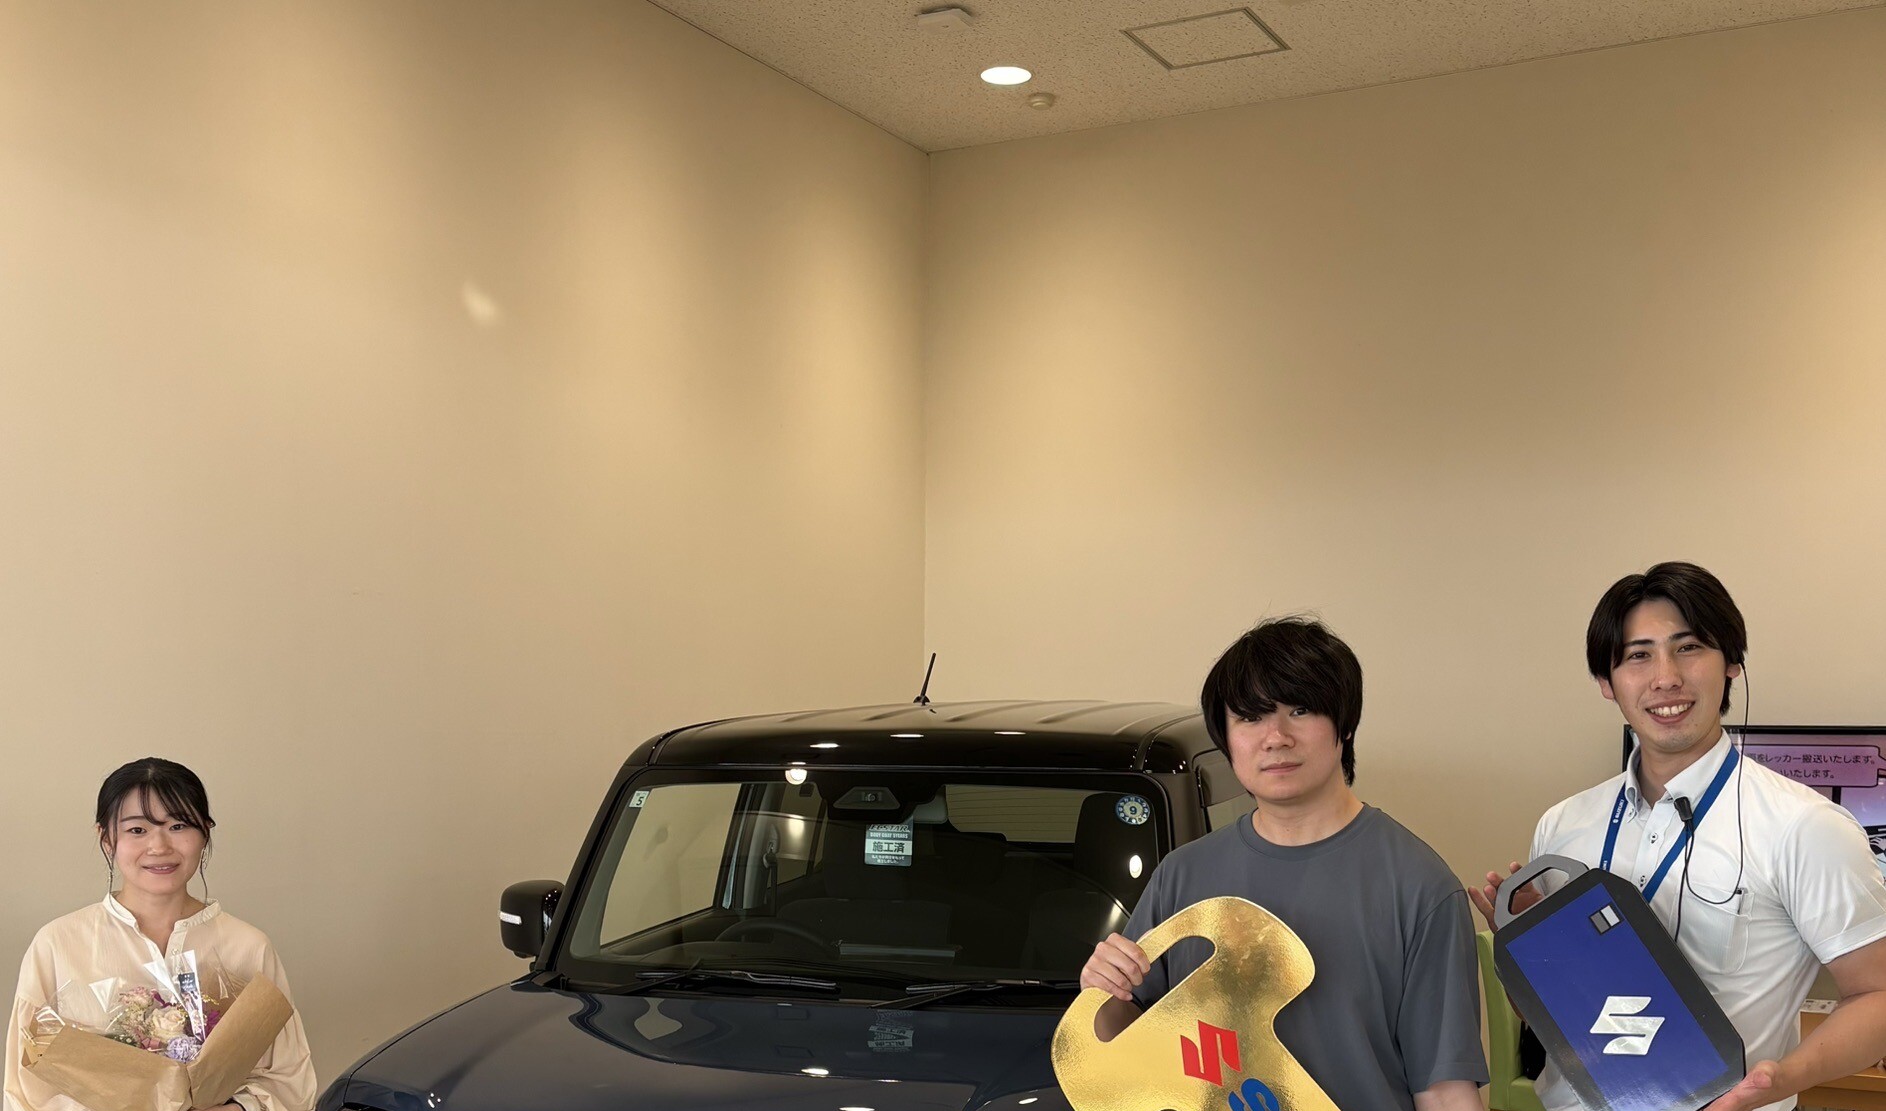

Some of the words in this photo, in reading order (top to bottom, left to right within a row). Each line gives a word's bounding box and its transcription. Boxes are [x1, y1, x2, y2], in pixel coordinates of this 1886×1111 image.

[1780, 769, 1834, 779] いたします。
[1130, 806, 1137, 815] 9
[873, 841, 905, 853] 施工済
